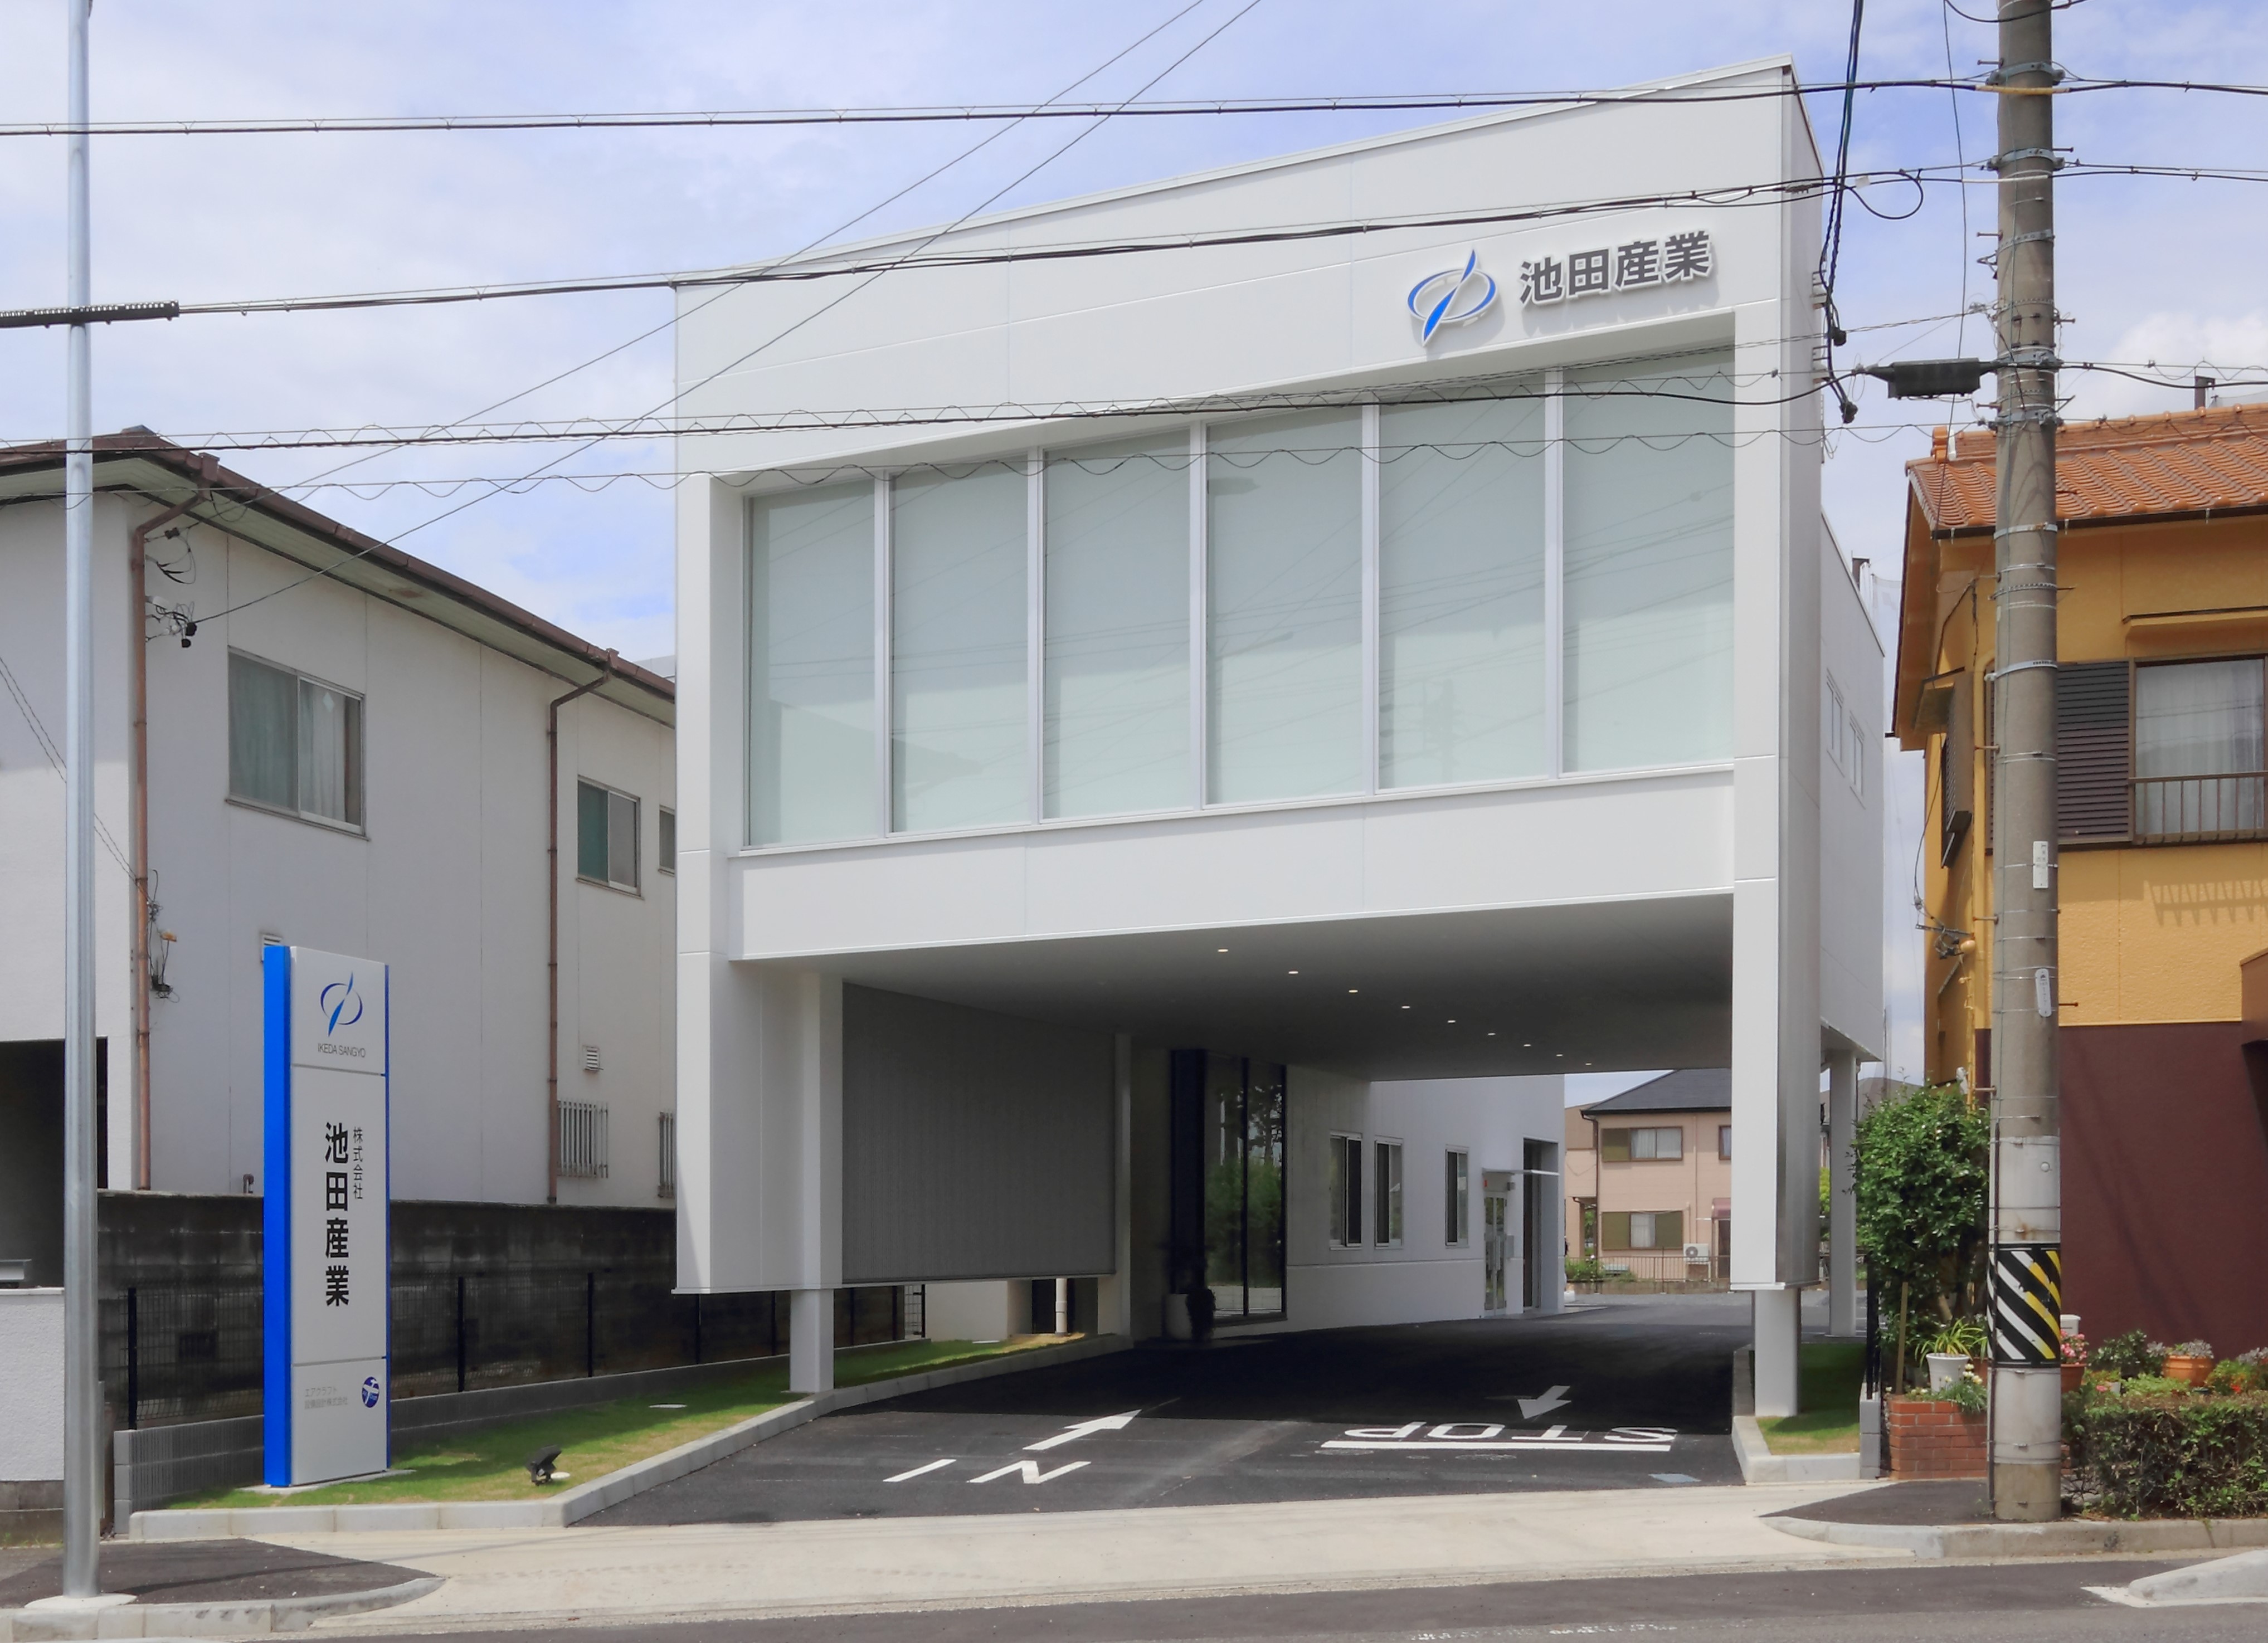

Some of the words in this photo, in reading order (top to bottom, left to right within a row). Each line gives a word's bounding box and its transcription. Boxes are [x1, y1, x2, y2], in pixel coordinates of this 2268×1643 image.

[1520, 231, 1711, 304] 池田産業
[318, 1044, 337, 1054] IKEDA
[339, 1046, 366, 1057] SANGYO
[353, 1127, 363, 1200] 株式会社
[325, 1122, 349, 1306] 池田産業
[1345, 1421, 1678, 1442] STOP
[883, 1459, 1091, 1484] IN
